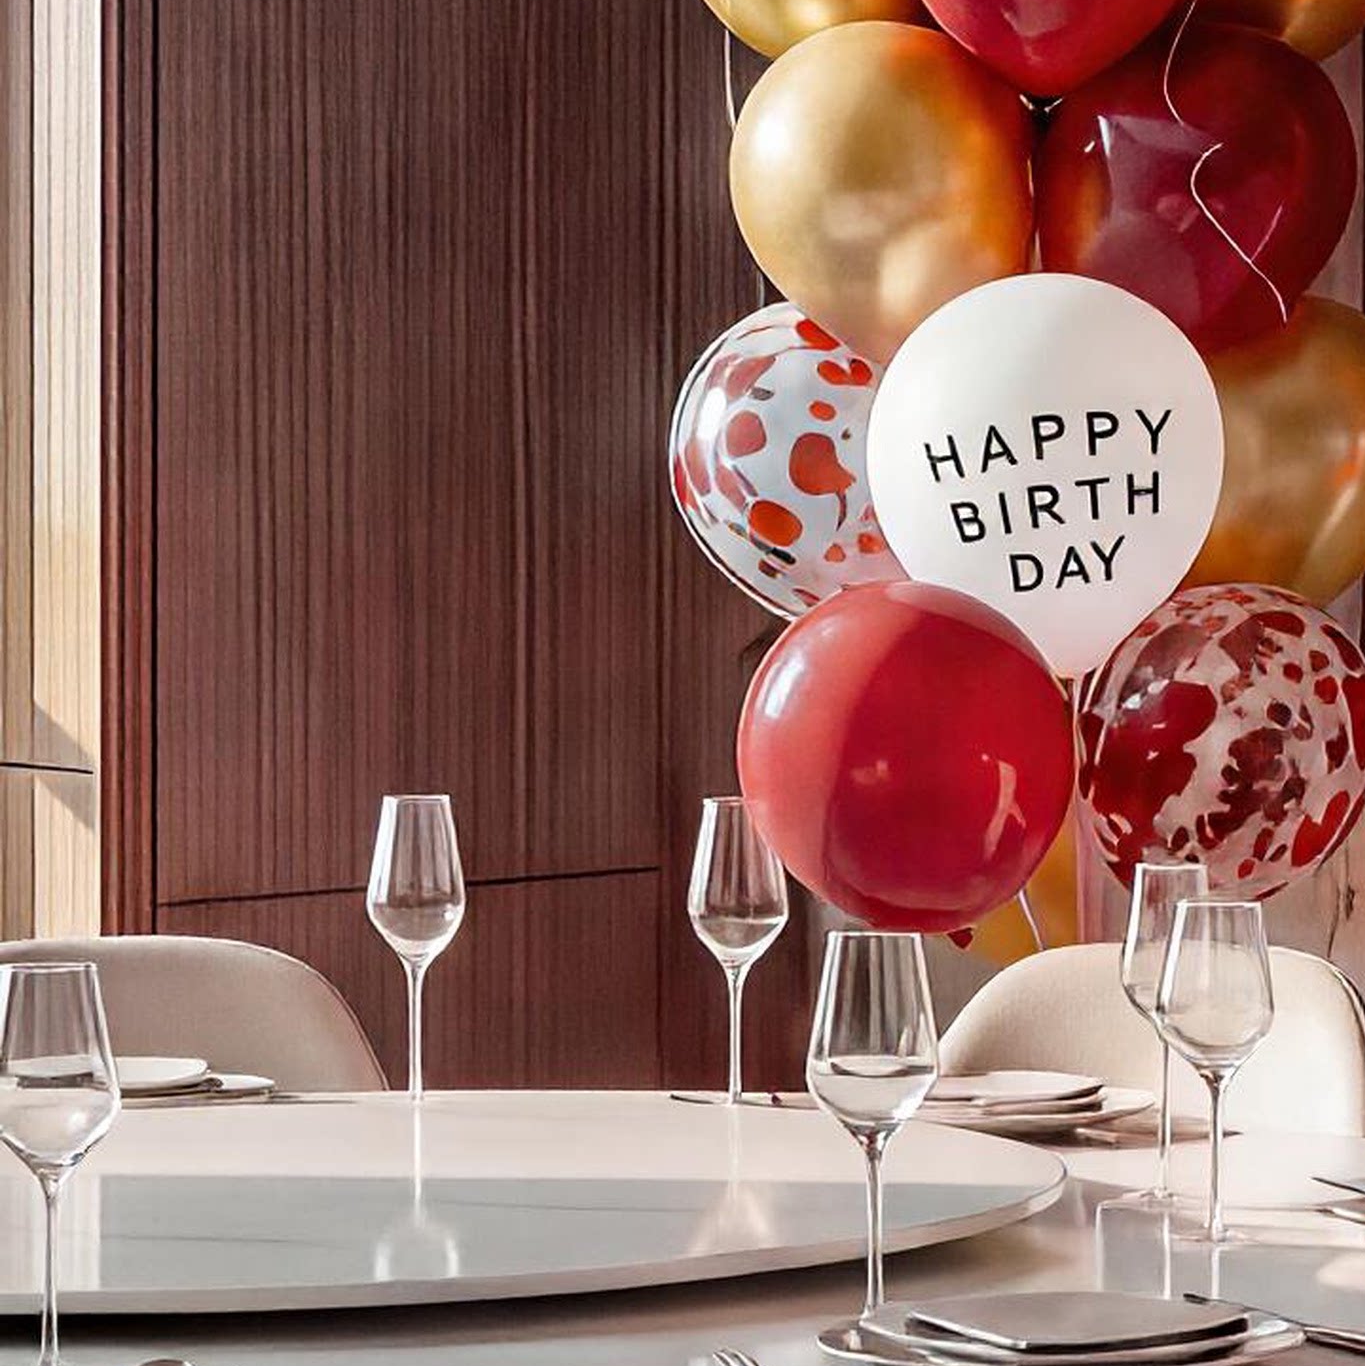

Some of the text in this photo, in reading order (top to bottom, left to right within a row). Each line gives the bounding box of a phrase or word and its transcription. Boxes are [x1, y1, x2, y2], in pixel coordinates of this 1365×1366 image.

[924, 409, 1172, 482] HAPPY
[950, 470, 1160, 543] BIRTH
[1009, 534, 1125, 593] DAY
